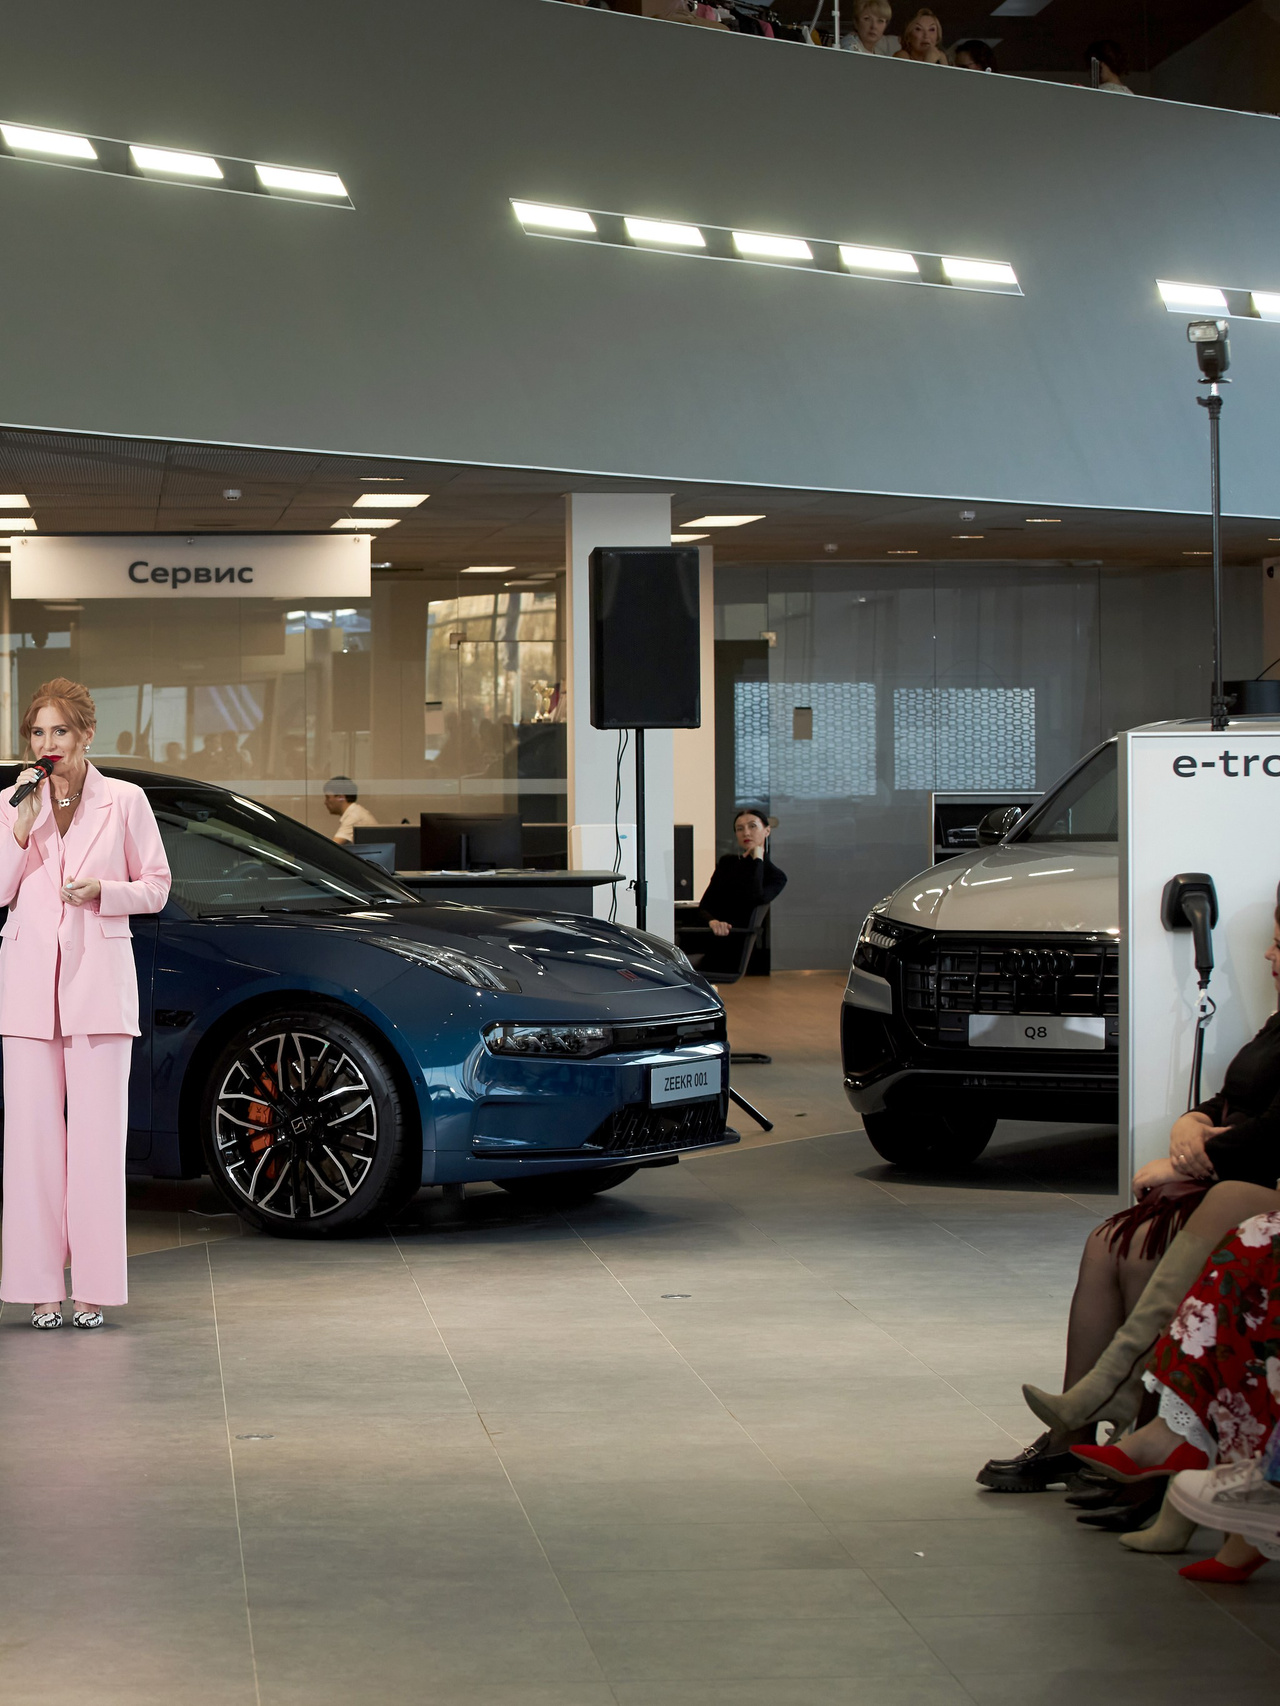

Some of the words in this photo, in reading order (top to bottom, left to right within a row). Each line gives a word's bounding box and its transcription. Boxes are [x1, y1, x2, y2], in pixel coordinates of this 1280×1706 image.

[128, 561, 253, 589] Сервис
[1173, 750, 1280, 777] e-tro
[1024, 1026, 1047, 1040] Q8
[664, 1074, 693, 1091] ZEEKR
[694, 1072, 708, 1086] 001
